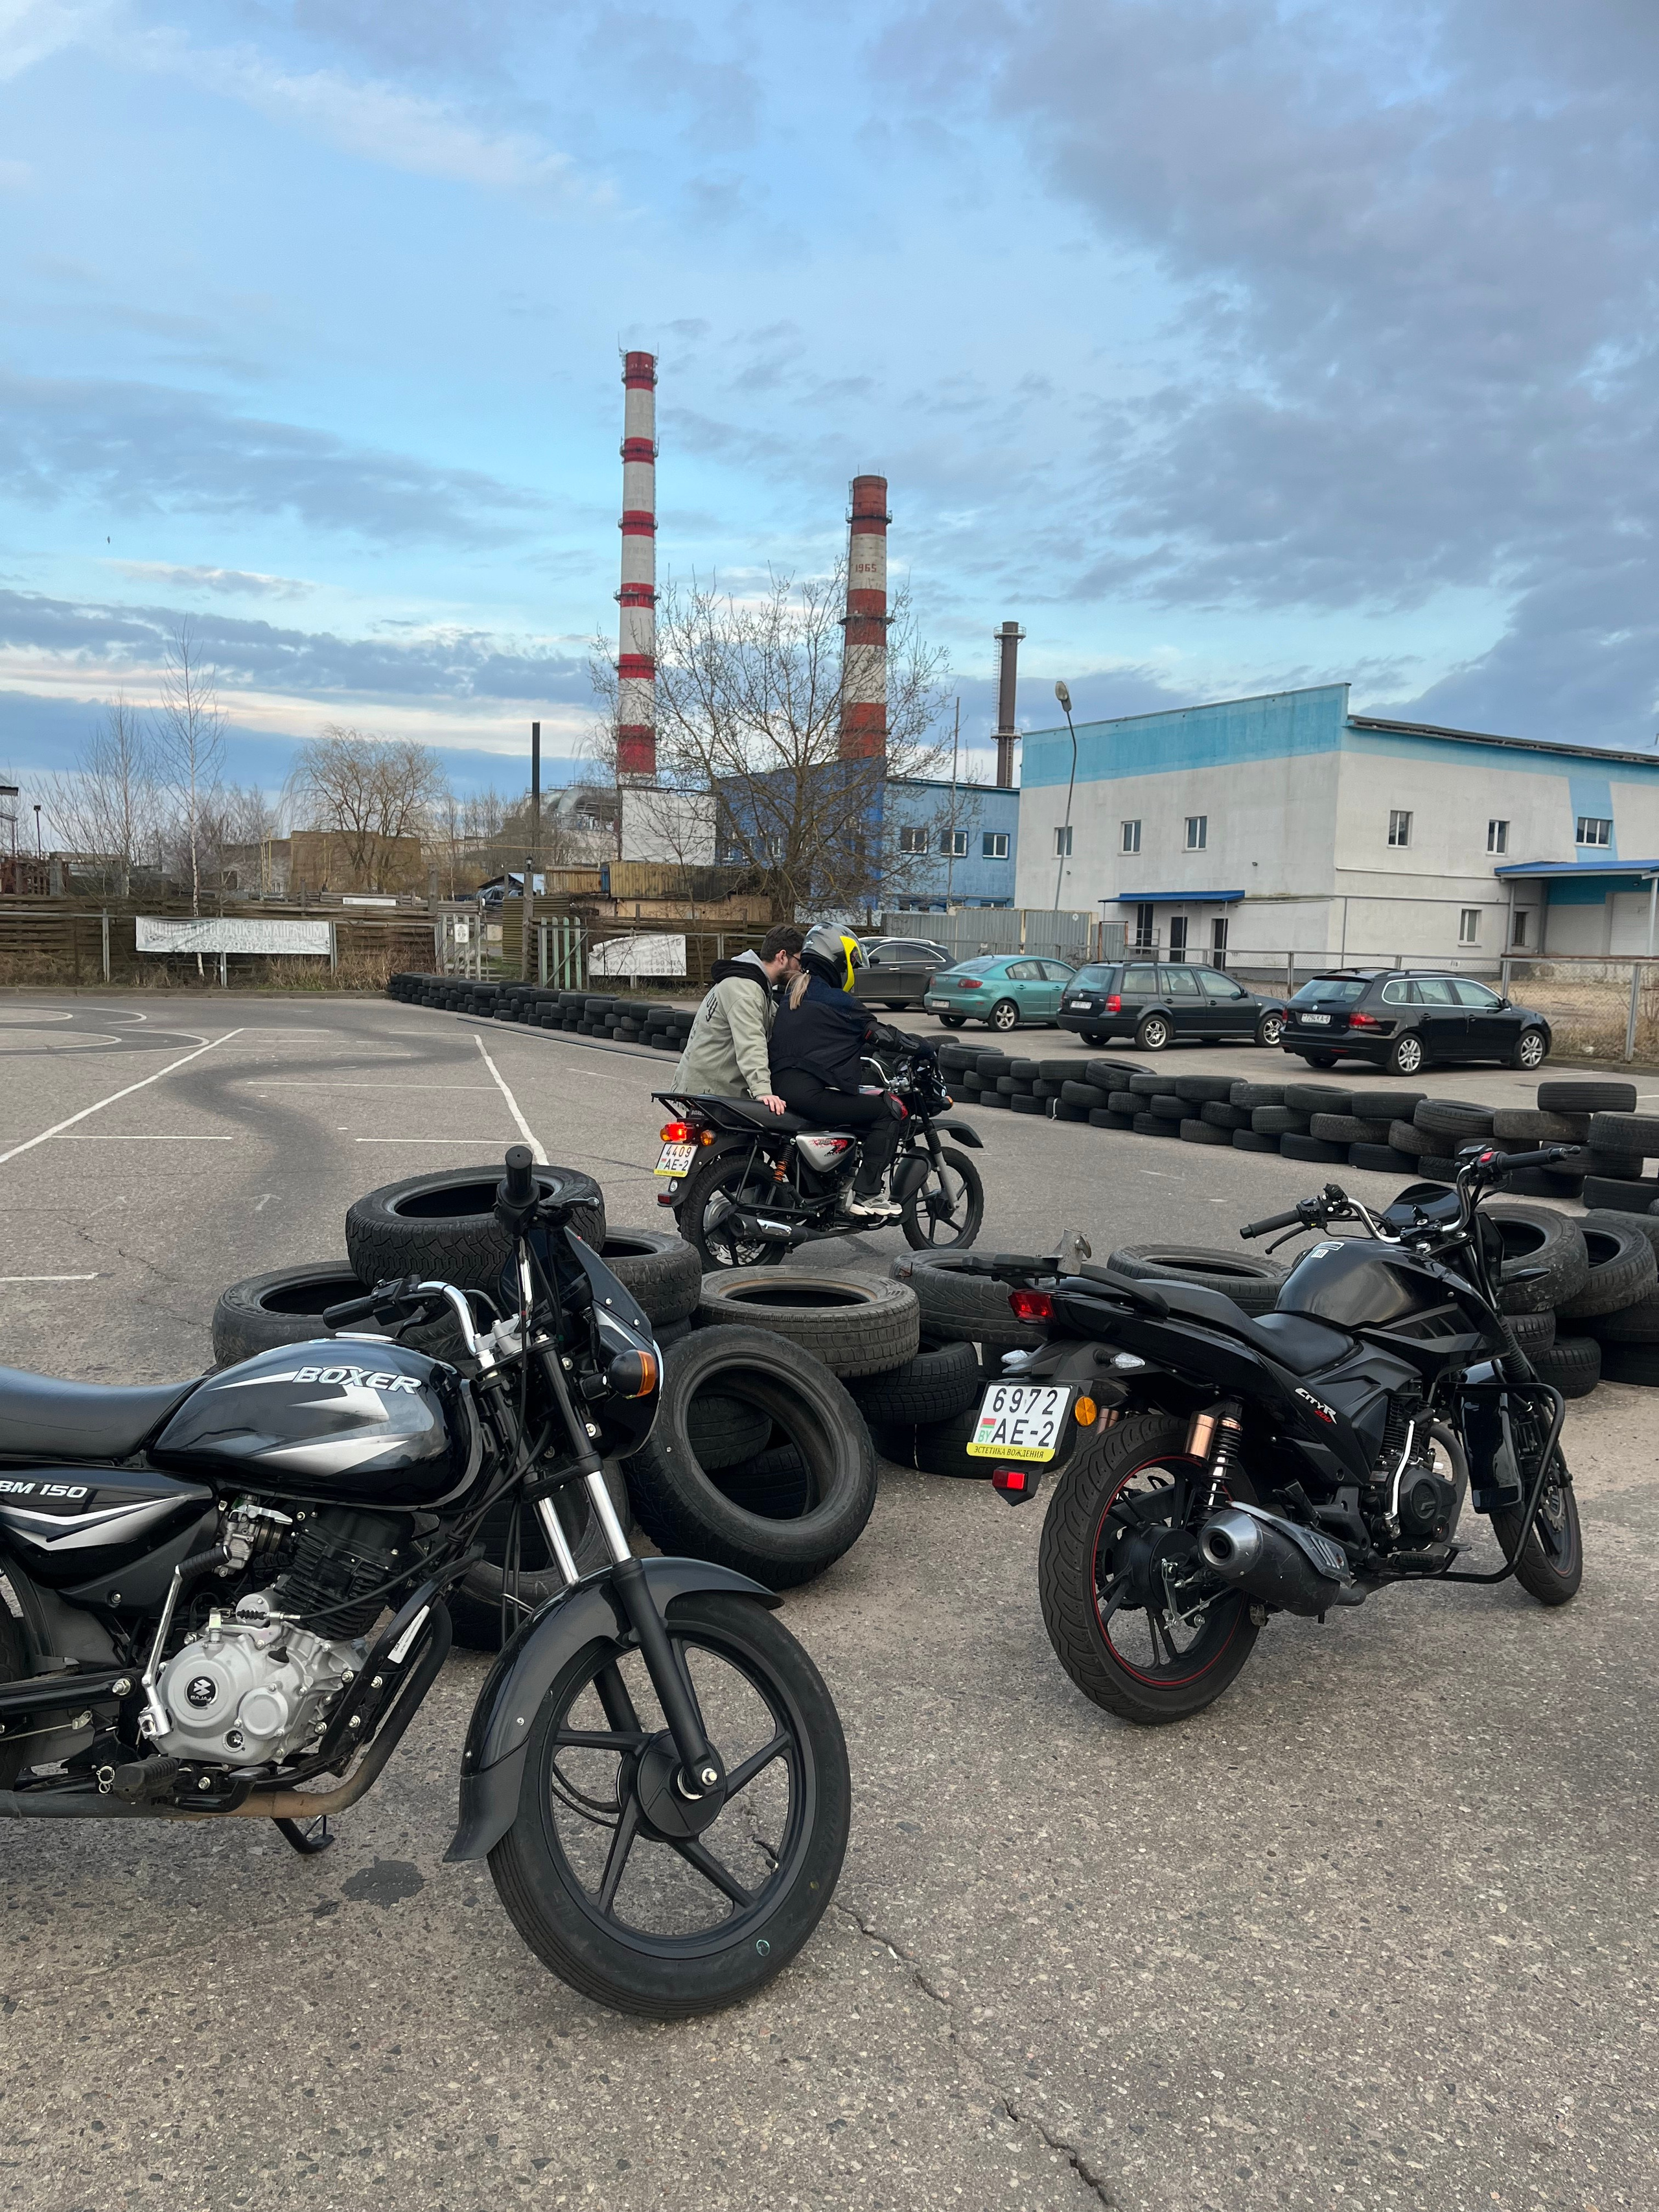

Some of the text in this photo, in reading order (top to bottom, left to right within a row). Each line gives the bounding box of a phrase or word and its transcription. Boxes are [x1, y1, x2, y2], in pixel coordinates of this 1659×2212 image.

[855, 564, 877, 572] 1965
[666, 1145, 692, 1158] 4409
[664, 1159, 689, 1171] AE-2
[292, 1366, 422, 1394] BOXER
[992, 1388, 1058, 1415] 6972
[977, 1430, 993, 1443] BY
[991, 1418, 1054, 1447] AE-2
[973, 1445, 1045, 1459] ЭСТЕТИКА ВОЖДЕНИЯ
[0, 1480, 89, 1499] BM 150
